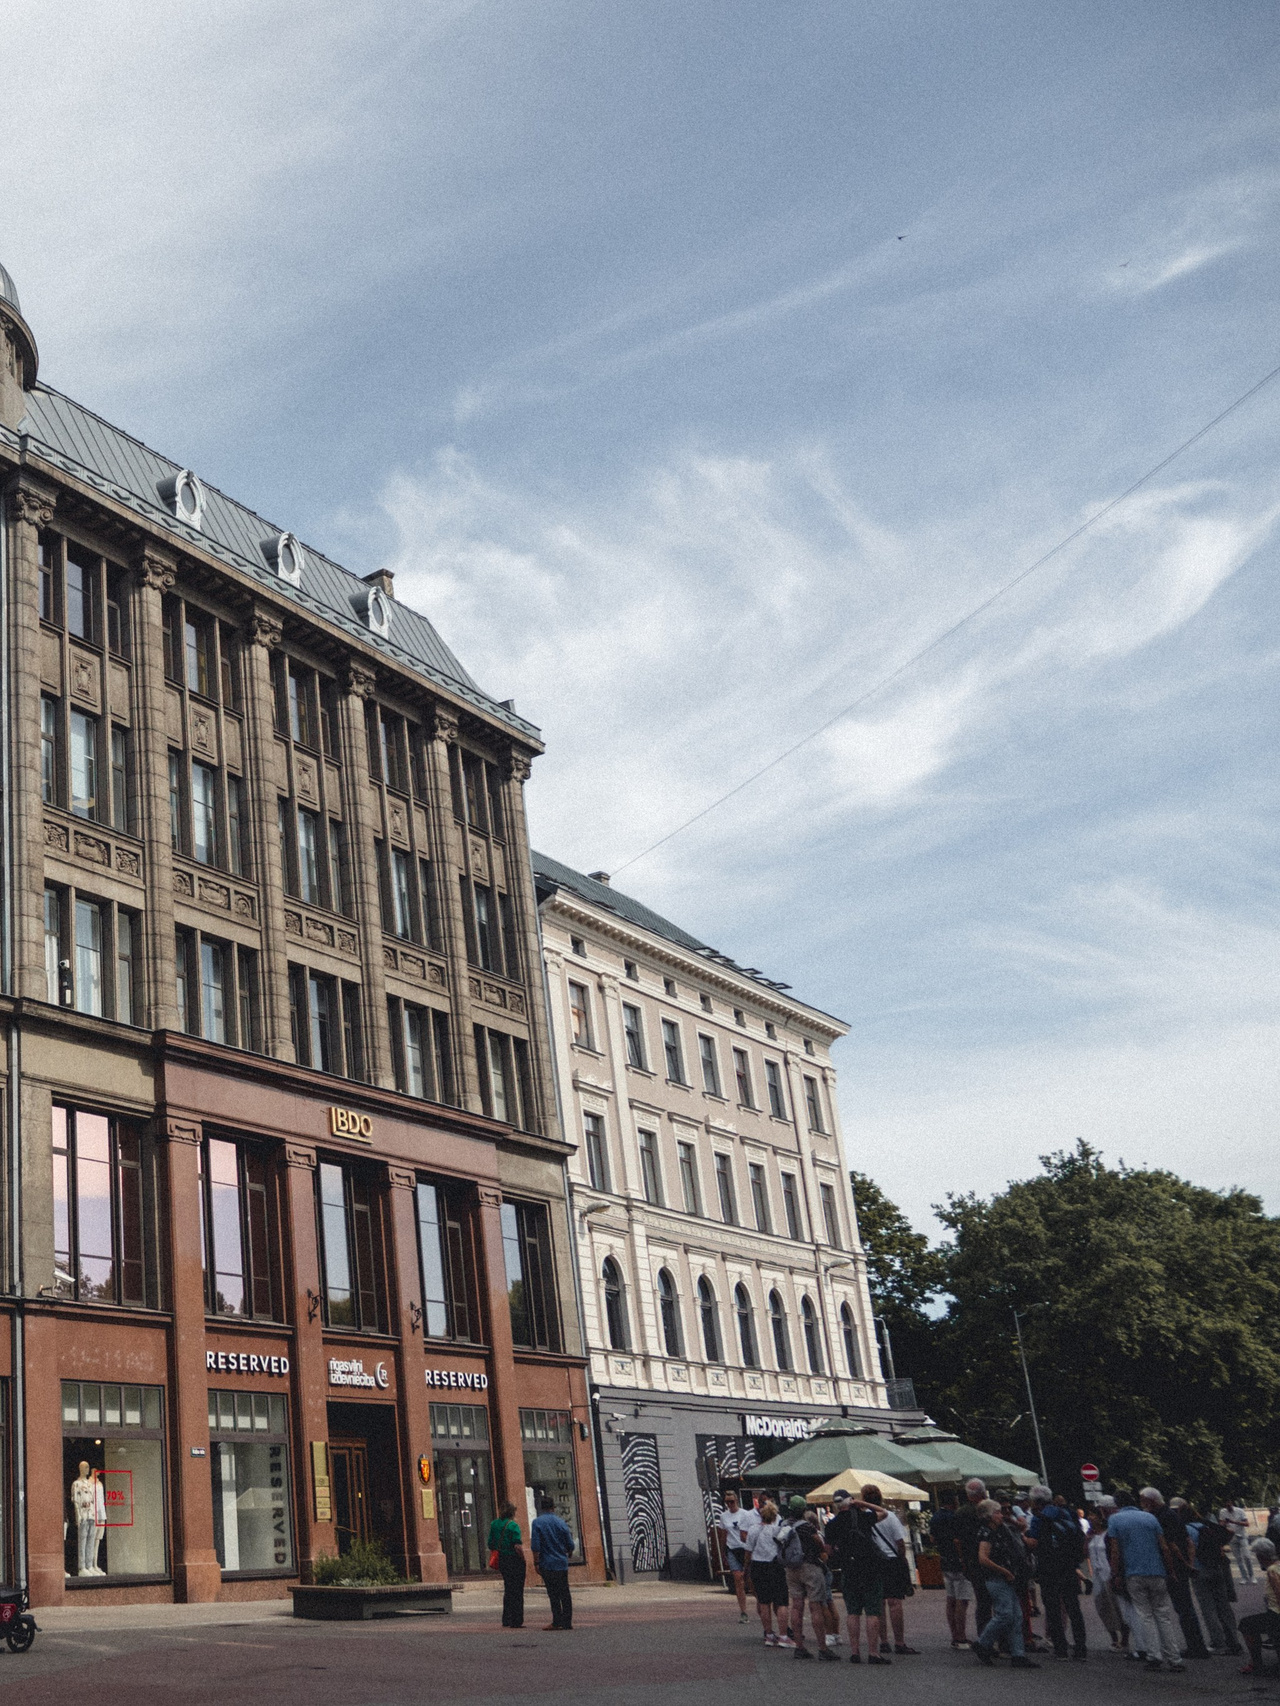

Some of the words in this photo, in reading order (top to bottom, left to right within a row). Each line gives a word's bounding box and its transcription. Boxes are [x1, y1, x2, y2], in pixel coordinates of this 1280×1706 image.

[337, 1107, 373, 1137] BDO
[206, 1351, 289, 1374] RESERVED
[425, 1369, 488, 1389] RESERVED
[746, 1415, 808, 1439] McDonald's
[269, 1446, 287, 1565] RESERVED
